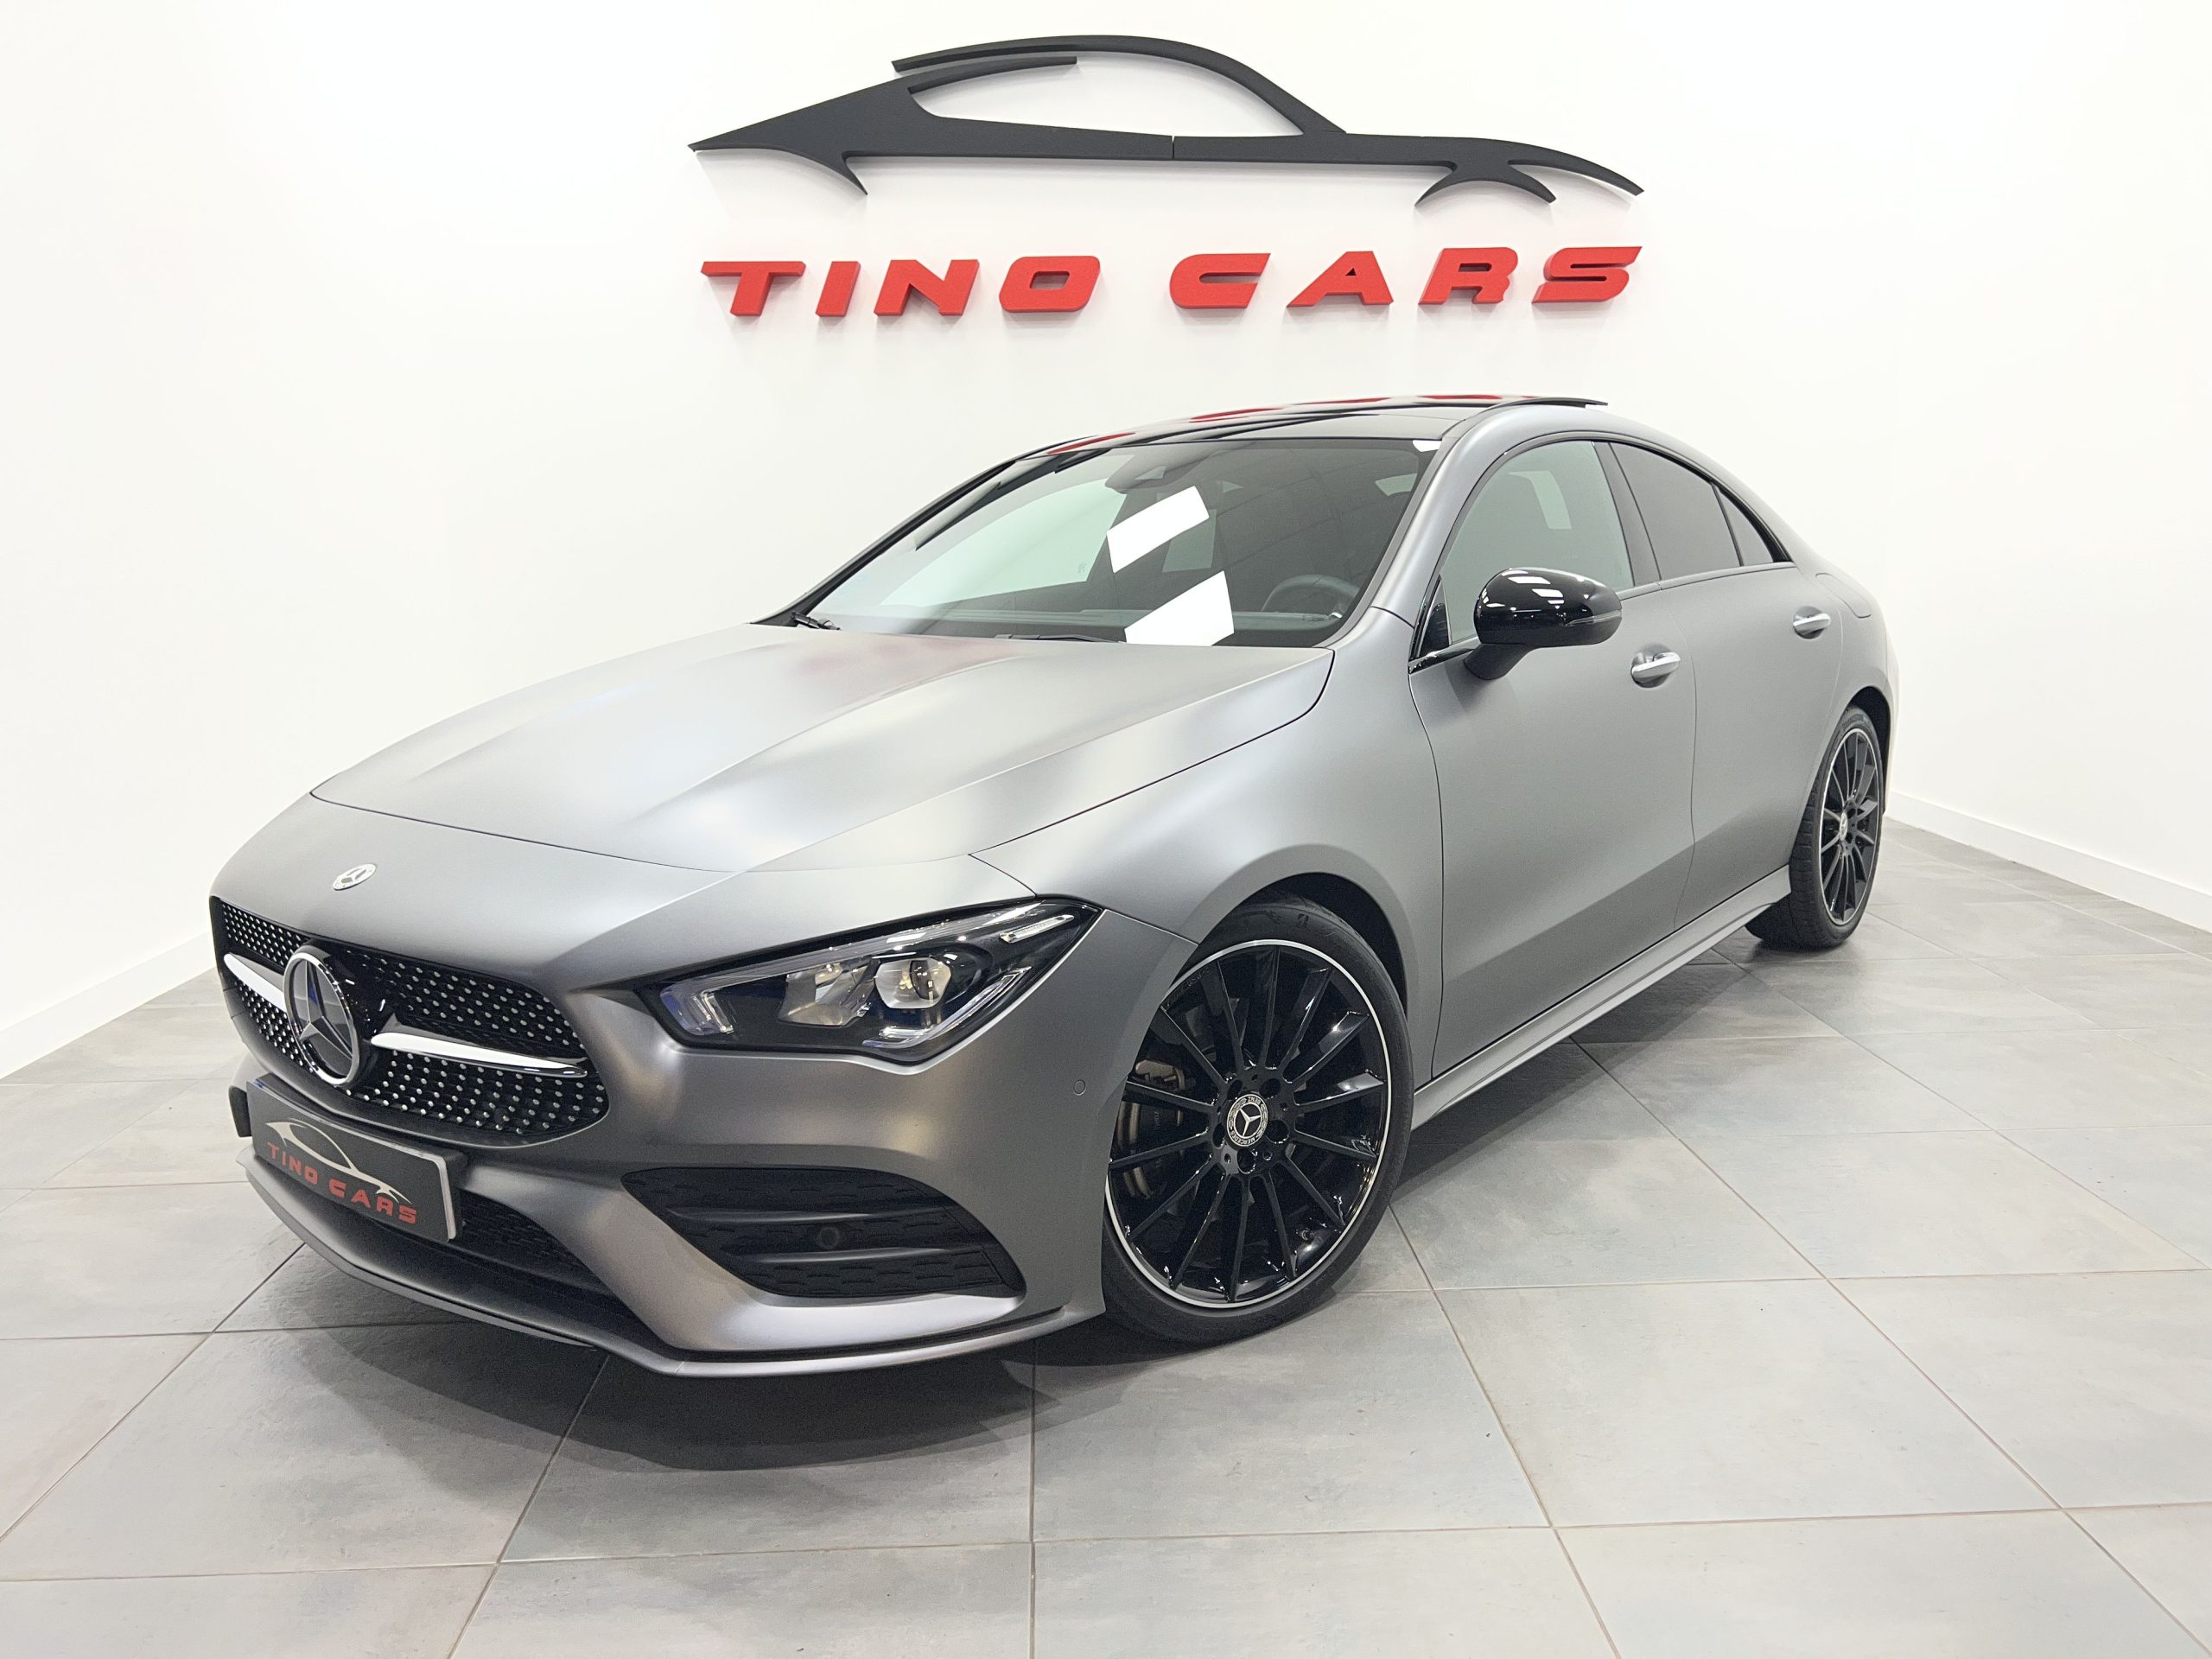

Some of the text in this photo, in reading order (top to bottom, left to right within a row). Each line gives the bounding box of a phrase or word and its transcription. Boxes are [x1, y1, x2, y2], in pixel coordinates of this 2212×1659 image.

[701, 245, 1643, 317] TINO CARS
[1248, 1096, 1262, 1105] BENZ
[1230, 1130, 1255, 1145] MERCEDES
[267, 1142, 416, 1224] TINO CARS
